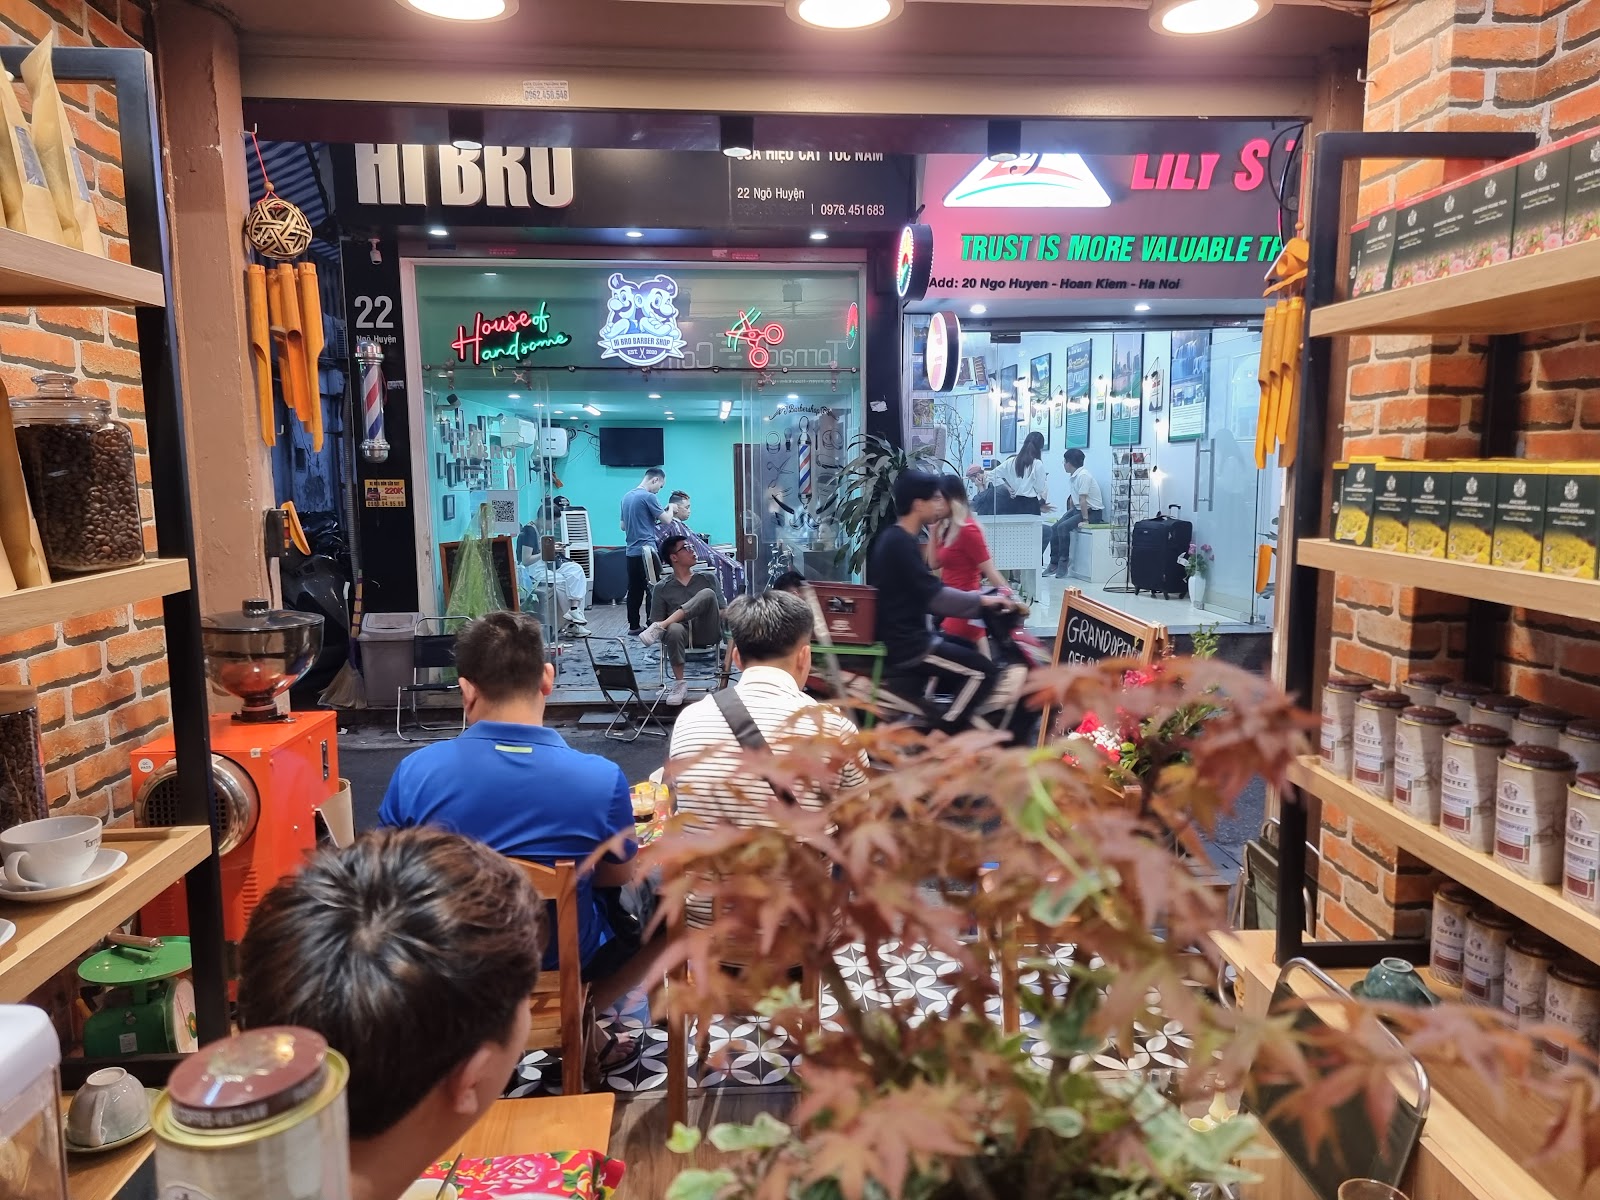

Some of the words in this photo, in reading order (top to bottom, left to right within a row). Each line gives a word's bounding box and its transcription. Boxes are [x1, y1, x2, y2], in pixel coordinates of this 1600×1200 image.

[355, 144, 427, 206] HI
[440, 145, 574, 208] BRO
[1130, 154, 1220, 190] LILY
[737, 188, 750, 199] 22
[754, 188, 772, 201] Ngõ
[776, 188, 804, 201] Huyện
[960, 234, 1033, 262] TRUST
[1036, 234, 1061, 261] IS
[1066, 236, 1136, 262] MORE
[1140, 236, 1251, 262] VALUABLE
[929, 277, 959, 289] Add:
[962, 278, 977, 289] 20
[980, 278, 1006, 291] Ngo
[1008, 278, 1048, 291] Huyen
[1060, 278, 1096, 289] Hoan
[1097, 278, 1127, 289] Kiem
[1139, 278, 1155, 289] Ha
[1158, 278, 1180, 290] Noi
[354, 296, 394, 328] 22
[452, 312, 532, 364] House
[531, 301, 550, 333] of
[1067, 616, 1112, 654] GRAND
